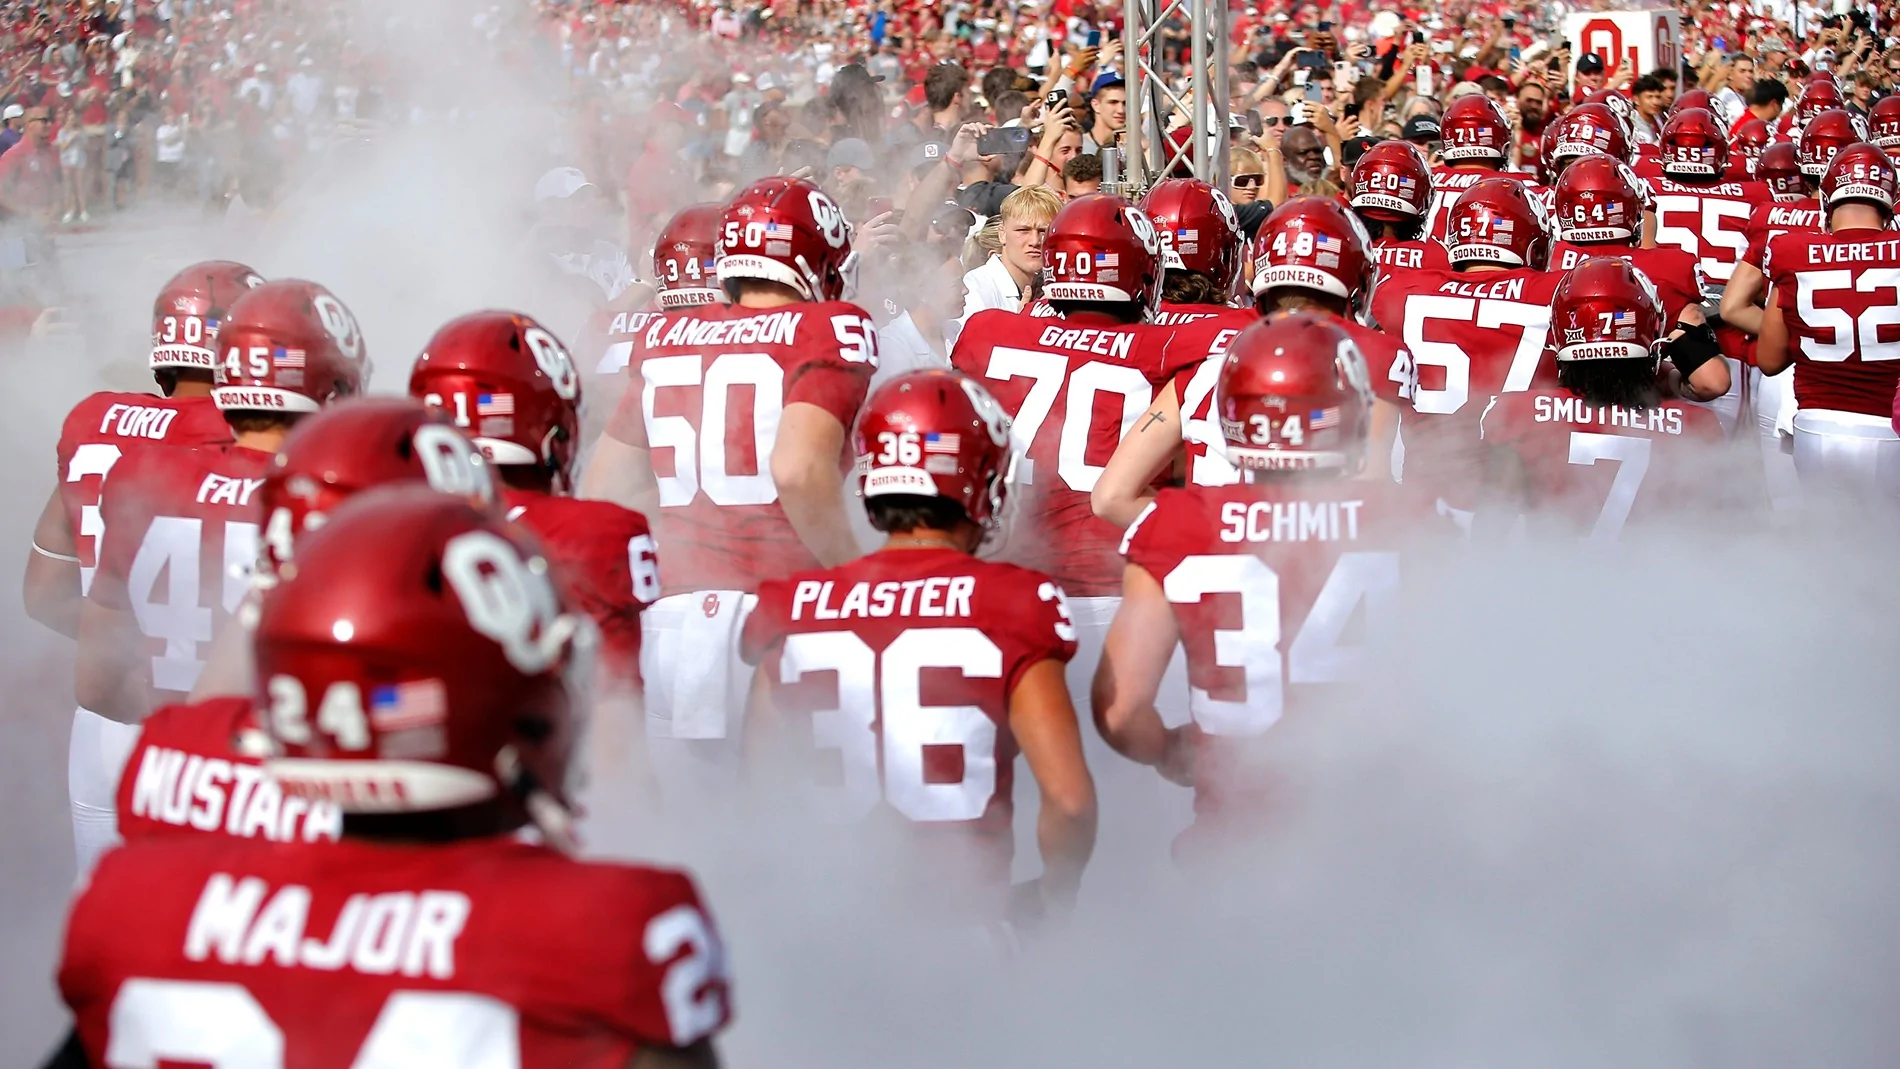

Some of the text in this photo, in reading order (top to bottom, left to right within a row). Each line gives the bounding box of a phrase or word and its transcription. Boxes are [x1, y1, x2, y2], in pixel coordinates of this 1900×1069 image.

[1581, 19, 1639, 98] OU
[1455, 128, 1476, 142] 71
[1569, 124, 1593, 140] 78
[1880, 121, 1899, 133] 77
[1452, 148, 1489, 157] SOONERS
[1559, 144, 1597, 154] SOONERS
[1677, 147, 1701, 162] 55
[1815, 145, 1837, 160] 19
[1370, 172, 1399, 190] 20
[1672, 165, 1708, 173] SOONERS
[1853, 164, 1880, 180] 52
[1361, 196, 1403, 210] SOONERS
[1844, 186, 1885, 198] SOONERS
[808, 190, 846, 249] OU
[1574, 204, 1604, 222] 64
[1767, 207, 1827, 228] McINTY
[724, 222, 763, 248] 50
[1460, 217, 1490, 237] 57
[1570, 230, 1614, 240] SOONERS
[1655, 196, 1750, 279] 55
[1156, 230, 1173, 250] 2
[1272, 232, 1314, 256] 48
[1453, 244, 1500, 259] SOONERS
[1808, 240, 1900, 264] EVERETT
[665, 258, 700, 283] 34
[1055, 252, 1091, 275] 70
[1263, 270, 1325, 286] SOONERS
[1439, 278, 1524, 300] ALLEN
[662, 292, 715, 305] SOONERS
[1051, 287, 1104, 300] SOONERS
[315, 294, 362, 359] OU
[1598, 312, 1613, 335] 7
[1795, 268, 1900, 362] 52
[163, 316, 202, 343] 30
[645, 311, 802, 349] B.ANDERSON
[830, 314, 879, 368] 50
[1566, 328, 1585, 342] XII
[1039, 325, 1135, 360] GREEN
[1403, 294, 1551, 414] 57
[1572, 346, 1629, 359] SOONERS
[153, 350, 211, 365] SOONERS
[226, 347, 269, 377] 45
[219, 391, 285, 407] SOONERS
[100, 403, 178, 440] FORD
[985, 346, 1153, 493] 70
[1534, 395, 1683, 435] SMOTHERS
[641, 354, 784, 507] 50
[1250, 414, 1304, 446] 34
[877, 432, 921, 466] 36
[196, 473, 266, 506] FAY
[1567, 432, 1652, 541] 7
[66, 444, 123, 597] 3
[1220, 500, 1363, 542] SCHMIT
[265, 506, 330, 562] 4
[628, 534, 661, 603] 6
[791, 576, 975, 621] PLASTER
[1038, 582, 1077, 642] 3
[1164, 553, 1400, 737] 34
[268, 674, 370, 752] 24
[781, 628, 1003, 822] 36
[183, 872, 472, 980] MAJOR
[643, 905, 730, 1046] 2
